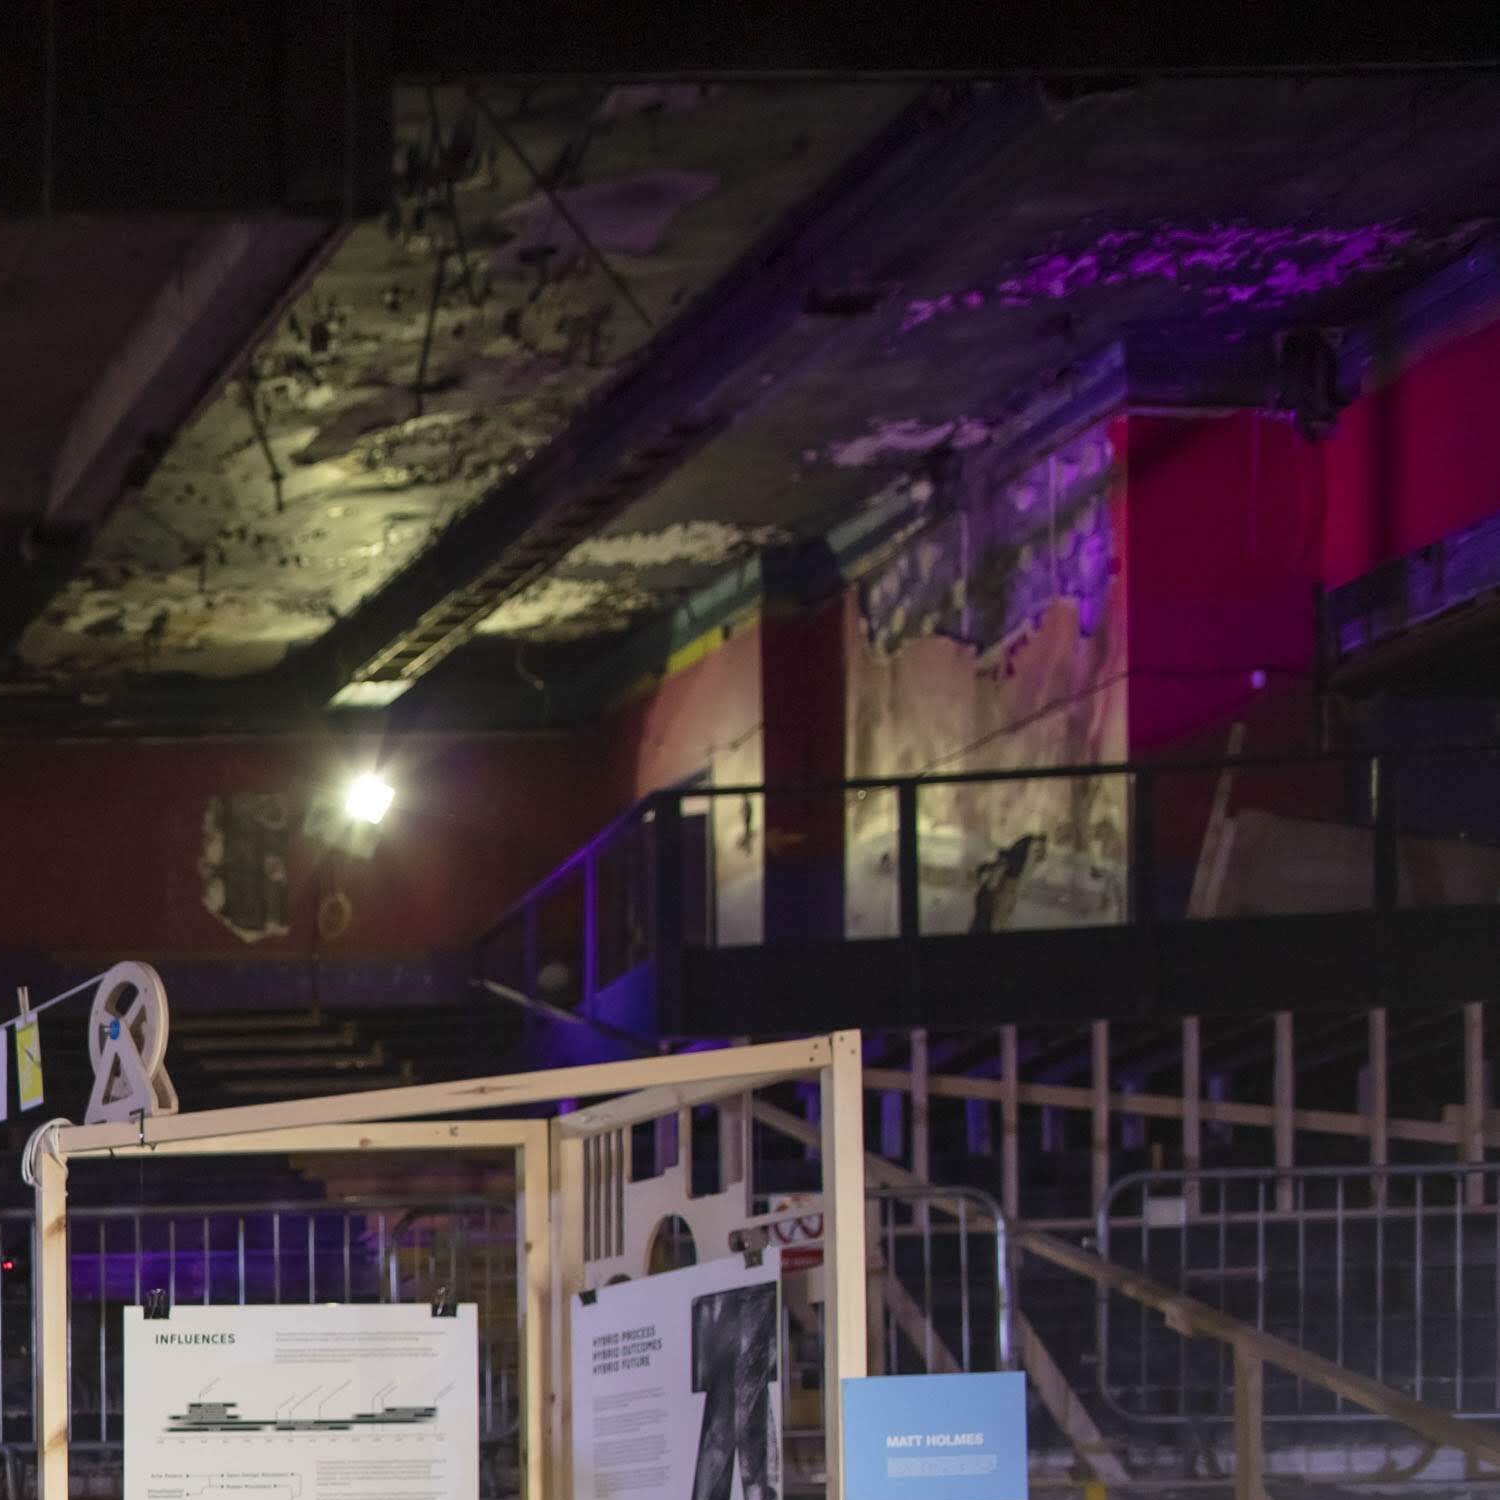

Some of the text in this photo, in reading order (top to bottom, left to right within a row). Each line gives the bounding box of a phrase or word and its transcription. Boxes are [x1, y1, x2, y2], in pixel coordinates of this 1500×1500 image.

[155, 1333, 236, 1345] INFLUENCES
[622, 1325, 656, 1340] PROCESS
[622, 1355, 649, 1369] FUTURE
[887, 1433, 984, 1448] MATT HOLMES
